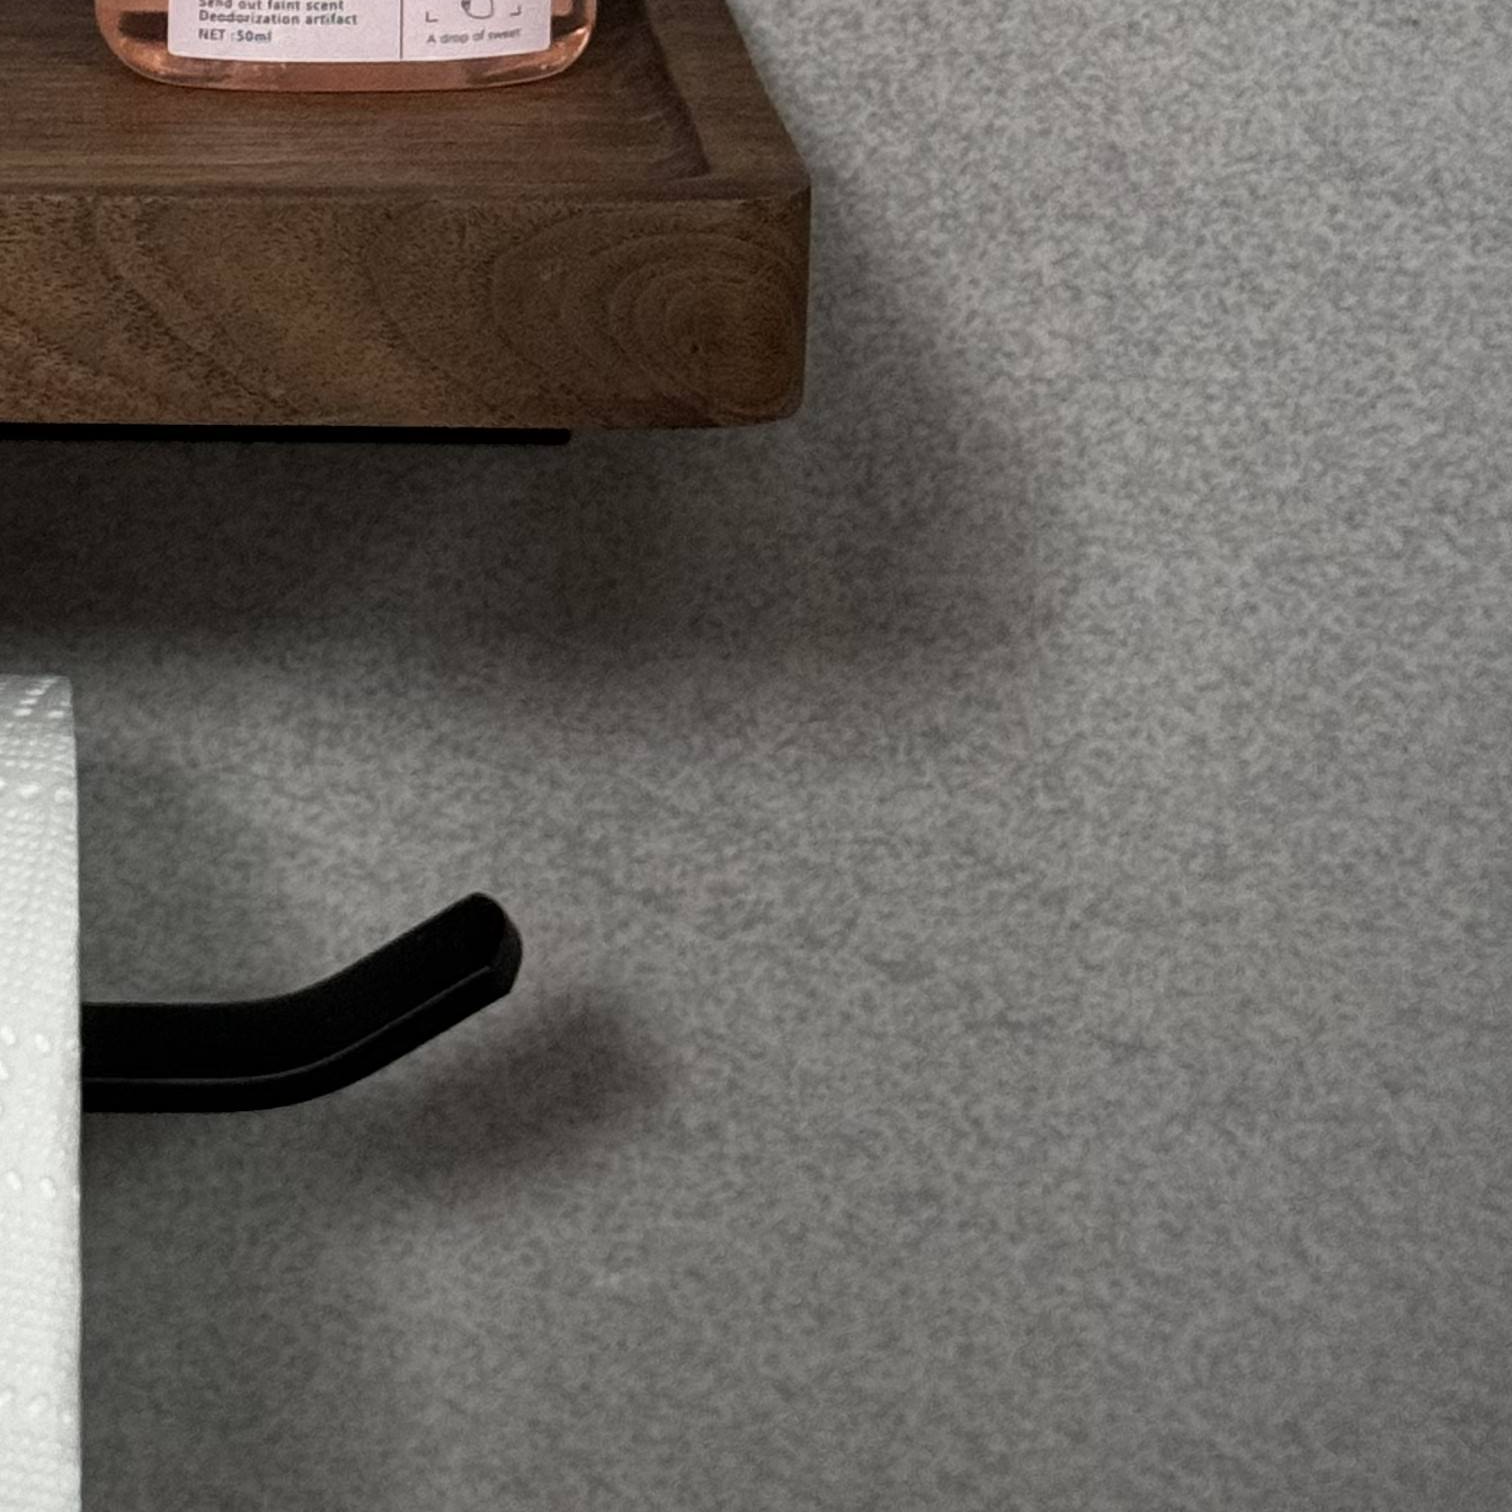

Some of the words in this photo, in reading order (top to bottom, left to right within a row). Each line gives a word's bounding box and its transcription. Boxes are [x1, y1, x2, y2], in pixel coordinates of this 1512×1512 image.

[238, 0, 262, 10] out
[306, 0, 344, 11] scent
[198, 10, 300, 25] Deodorization
[305, 13, 358, 26] artifact
[198, 28, 226, 41] NET
